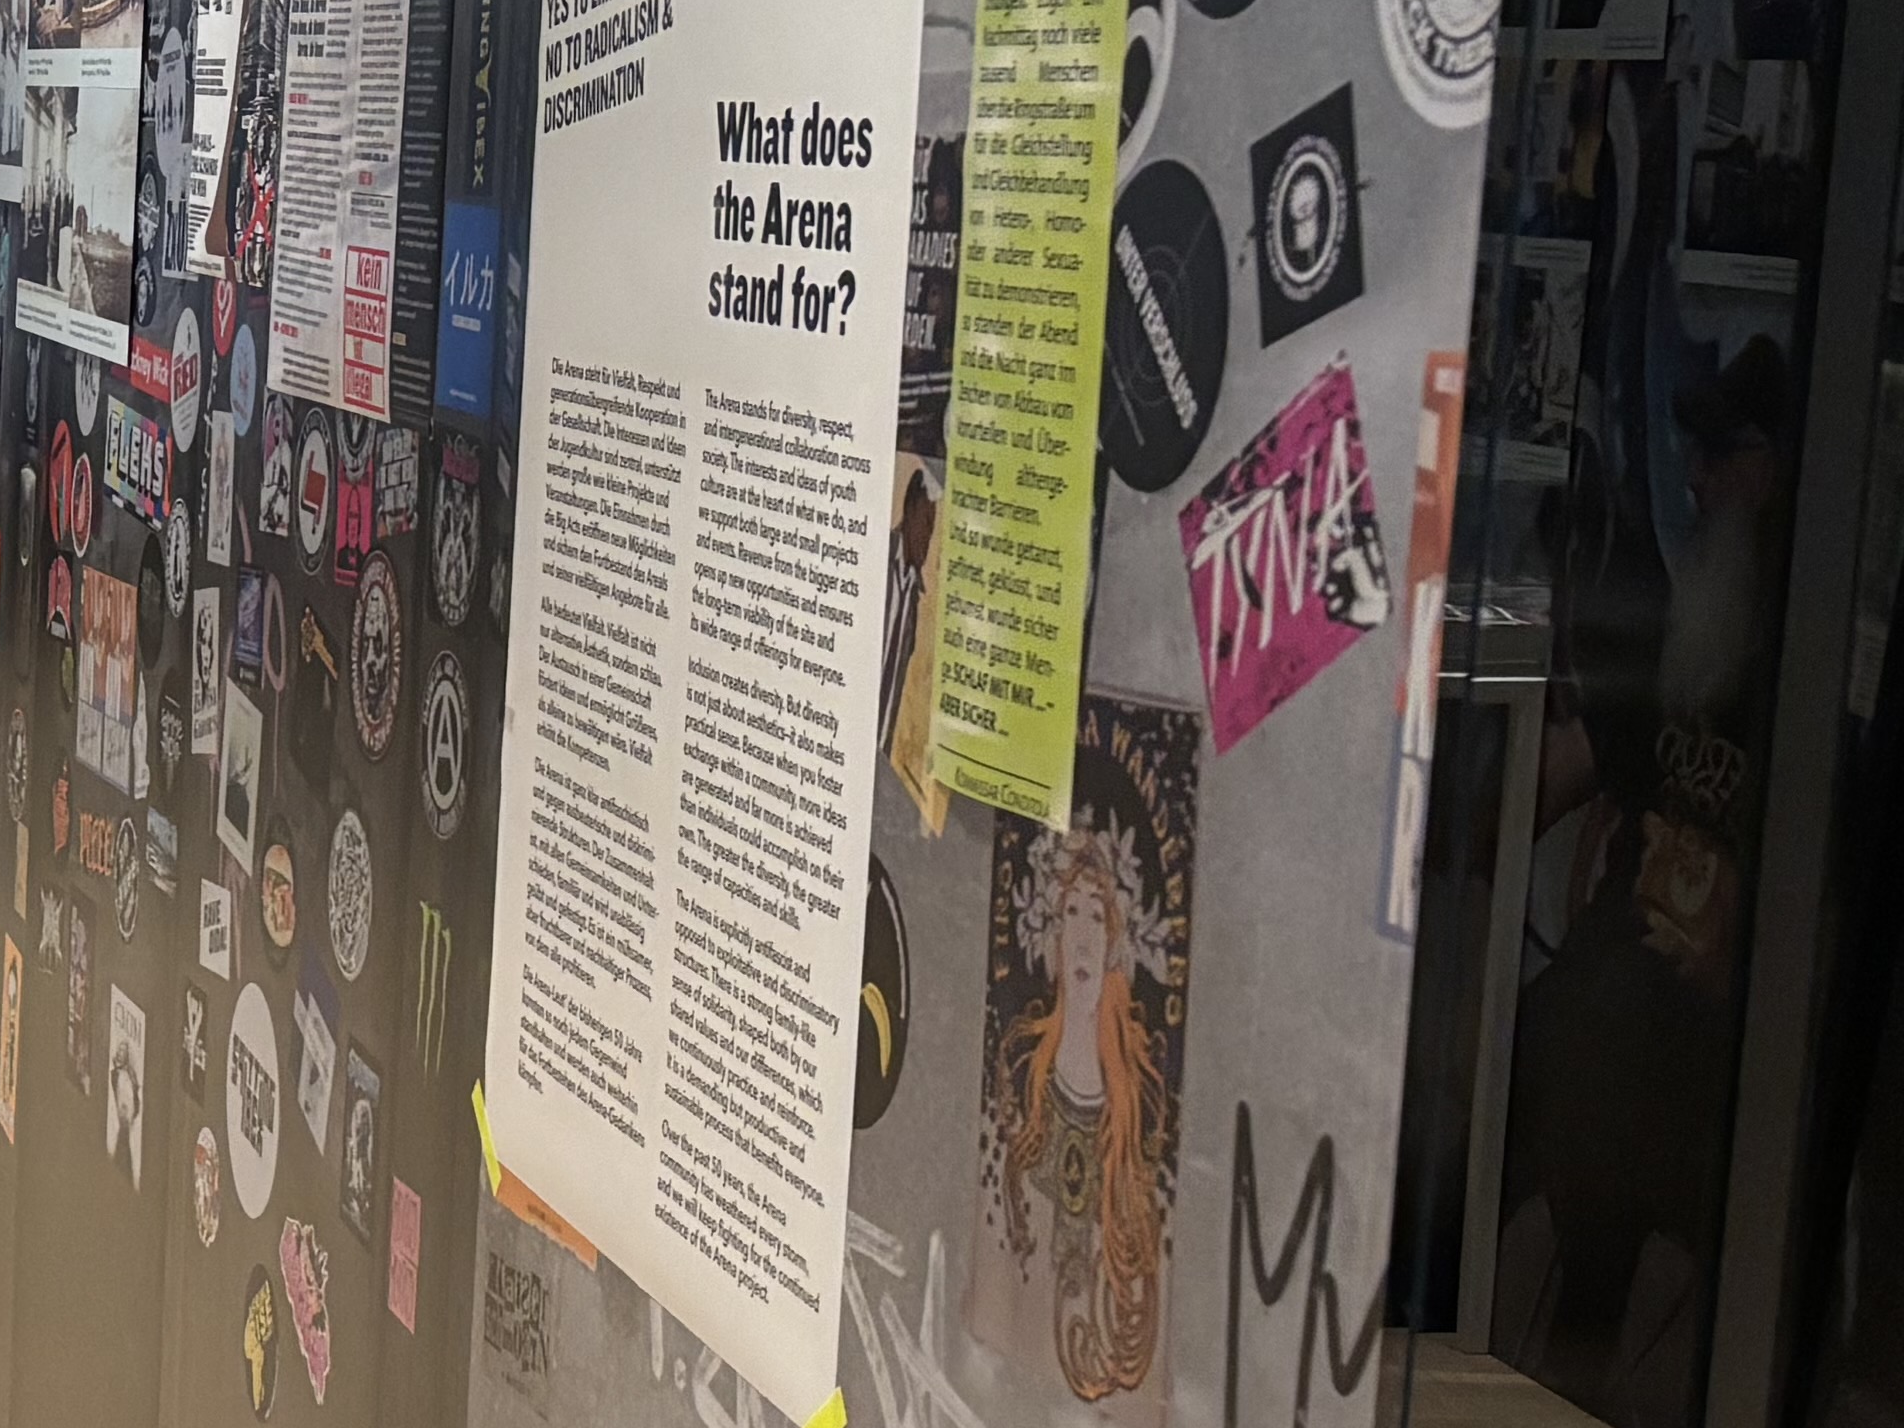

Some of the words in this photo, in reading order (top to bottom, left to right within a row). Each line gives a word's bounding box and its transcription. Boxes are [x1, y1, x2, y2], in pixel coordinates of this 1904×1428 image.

[546, 41, 562, 82] NO
[565, 33, 581, 73] TO
[544, 57, 644, 133] DISCRIMINATION
[717, 101, 794, 165] What
[801, 101, 873, 168] does
[713, 179, 755, 243] the
[761, 181, 852, 253] Arena
[356, 252, 382, 290] kein
[444, 247, 495, 311] イルカ
[709, 264, 784, 326] stand
[792, 265, 856, 336] for?
[704, 418, 718, 436] and
[719, 419, 784, 453] intergenerational
[784, 437, 839, 465] collaboration
[841, 453, 871, 474] across
[705, 388, 718, 409] The
[719, 392, 740, 413] Arena
[741, 400, 767, 420] stands
[769, 400, 781, 422] for
[782, 405, 817, 436] diversity,
[819, 418, 854, 443] respect,
[698, 505, 710, 519] we
[710, 510, 739, 531] support
[739, 512, 758, 535] both
[759, 518, 781, 547] large
[782, 528, 798, 548] and
[799, 534, 821, 554] small
[821, 540, 859, 567] projects
[662, 1119, 680, 1146] Over
[681, 1134, 693, 1156] the
[694, 1148, 710, 1170] past
[711, 1156, 722, 1178] 50
[722, 1169, 745, 1199] years,
[747, 1182, 760, 1207] the
[762, 1194, 786, 1227] Arena
[655, 1204, 689, 1240] existence
[690, 1229, 699, 1247] of
[700, 1235, 712, 1259] the
[712, 1246, 737, 1278] Arena
[738, 1270, 769, 1304] project.
